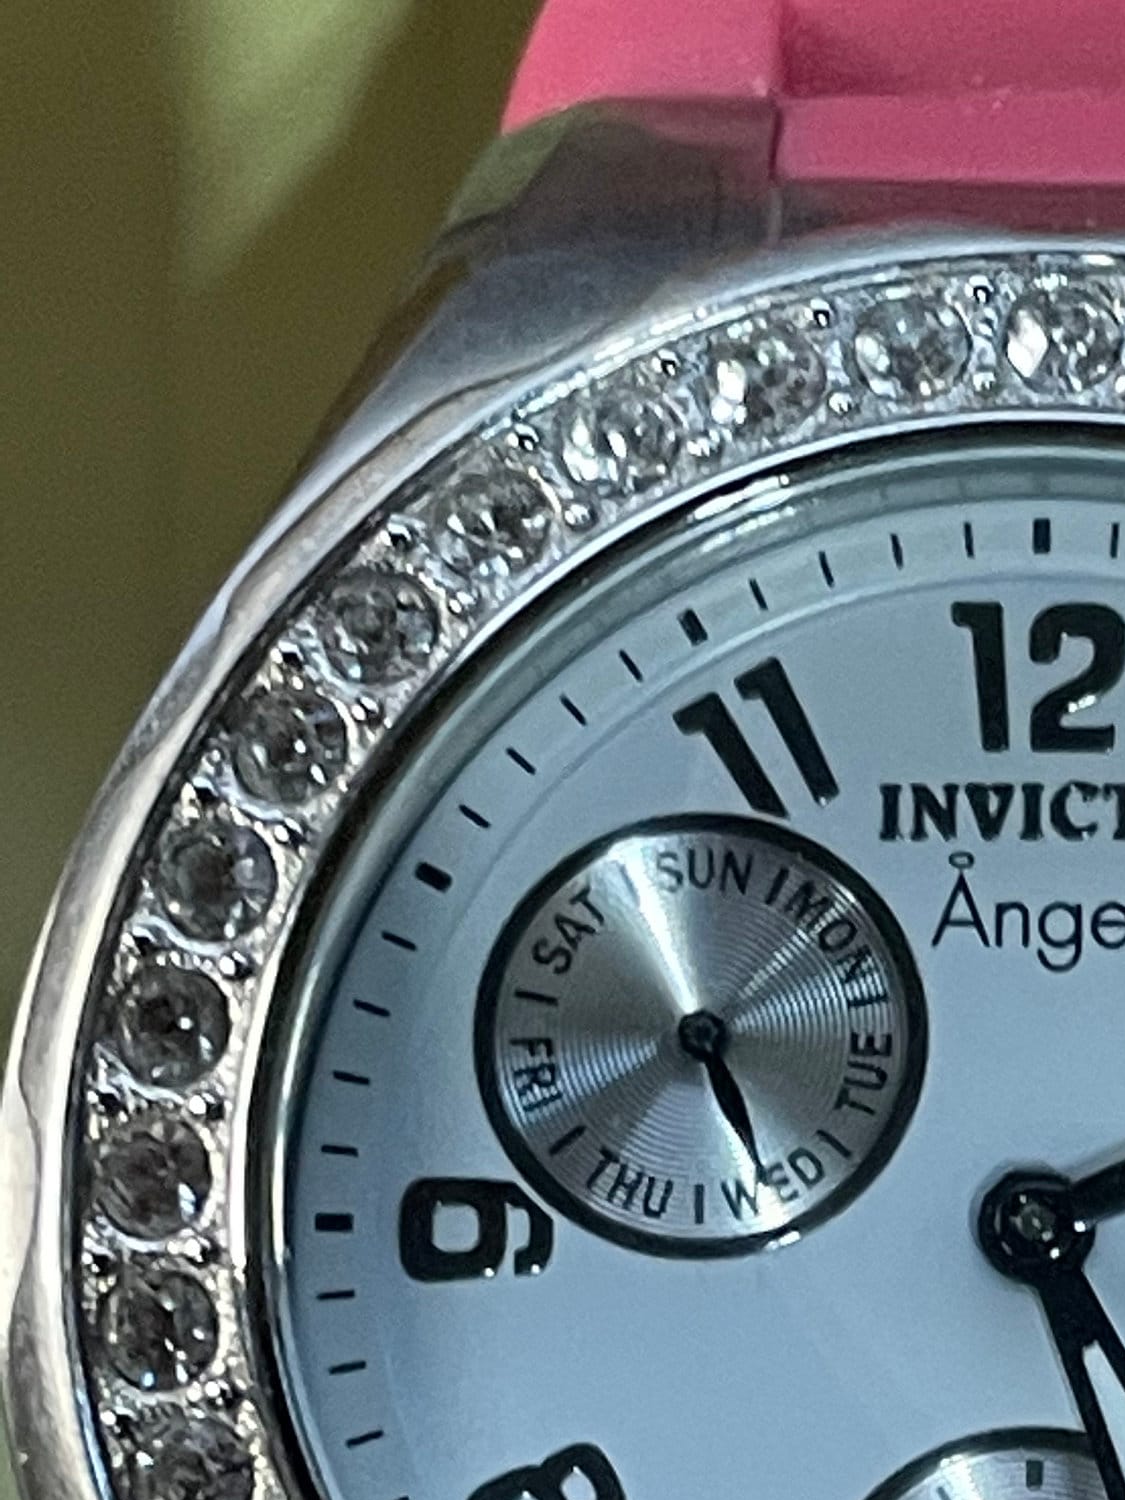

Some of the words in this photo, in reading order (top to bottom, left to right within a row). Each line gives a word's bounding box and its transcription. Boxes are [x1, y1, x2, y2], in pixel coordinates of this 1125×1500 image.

[672, 656, 840, 819] 11
[656, 848, 754, 896] SUN
[532, 886, 607, 975] SAT
[784, 880, 887, 986] MON
[508, 1037, 564, 1113] FRI
[834, 1031, 893, 1117] TUE
[584, 1149, 675, 1219] THU
[720, 1147, 825, 1220] WED
[400, 1176, 553, 1282] 9
